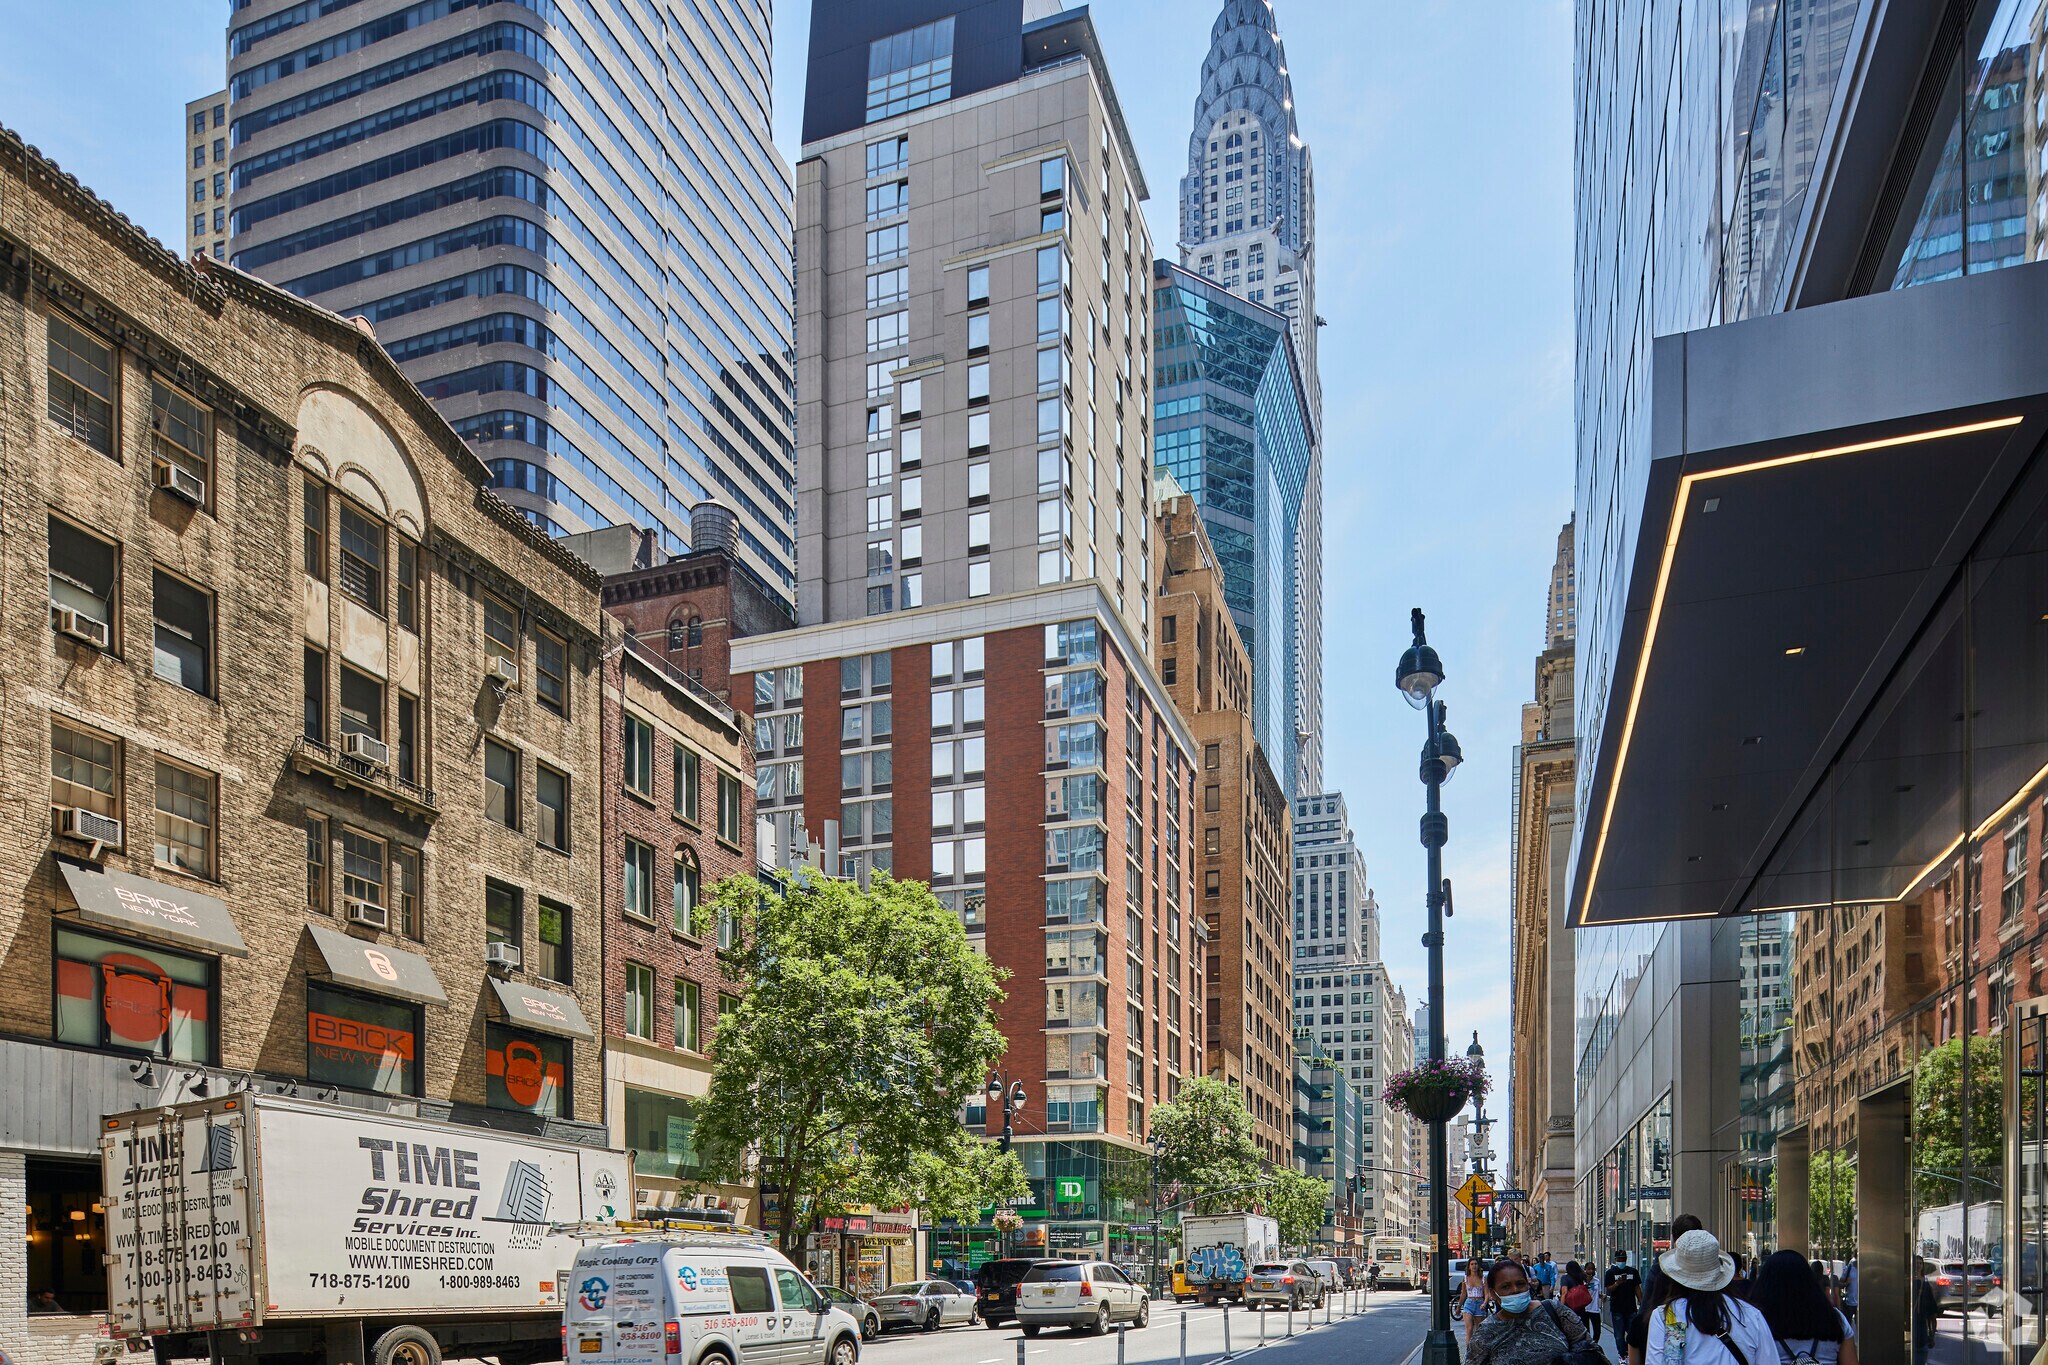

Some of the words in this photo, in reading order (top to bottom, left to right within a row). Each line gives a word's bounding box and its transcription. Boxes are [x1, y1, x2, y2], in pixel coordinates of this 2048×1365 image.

[114, 887, 195, 919] BRICK
[121, 902, 155, 917] NEW
[158, 911, 200, 928] YORK
[521, 996, 565, 1015] BRICK
[527, 1007, 546, 1017] NEW
[546, 1012, 568, 1022] YORK
[315, 1017, 406, 1054] BRICK
[315, 1046, 357, 1063] NEW
[361, 1055, 408, 1073] YORK
[507, 1074, 540, 1088] BRICK
[122, 1135, 184, 1166] TIME
[358, 1136, 481, 1191] TIME
[1060, 1181, 1082, 1197] TD
[357, 1187, 479, 1220] Shred
[1008, 1195, 1037, 1205] ank
[122, 1202, 147, 1220] MOBLE
[351, 1217, 455, 1238] Services
[455, 1227, 481, 1239] Inc.
[849, 1218, 867, 1230] LOTTO
[345, 1236, 383, 1252] MOBILE
[385, 1238, 436, 1254] DOCUMENT
[438, 1241, 495, 1255] DESTRUCTION
[865, 1238, 876, 1246] WE
[877, 1238, 892, 1246] BUY
[893, 1238, 907, 1246] GOL
[349, 1254, 494, 1271] WWW.TIMESHRED.COM
[576, 1257, 600, 1268] Magic
[601, 1256, 635, 1267] Cooling
[635, 1256, 660, 1266] Corp.
[309, 1272, 410, 1289] 718-875-1200
[439, 1274, 520, 1289] 1-800-989-8463
[700, 1267, 721, 1277] Magic
[633, 1324, 648, 1332] 516
[704, 1319, 719, 1330] 516
[721, 1316, 759, 1328] 938-8100
[620, 1331, 662, 1340] 938-8100
